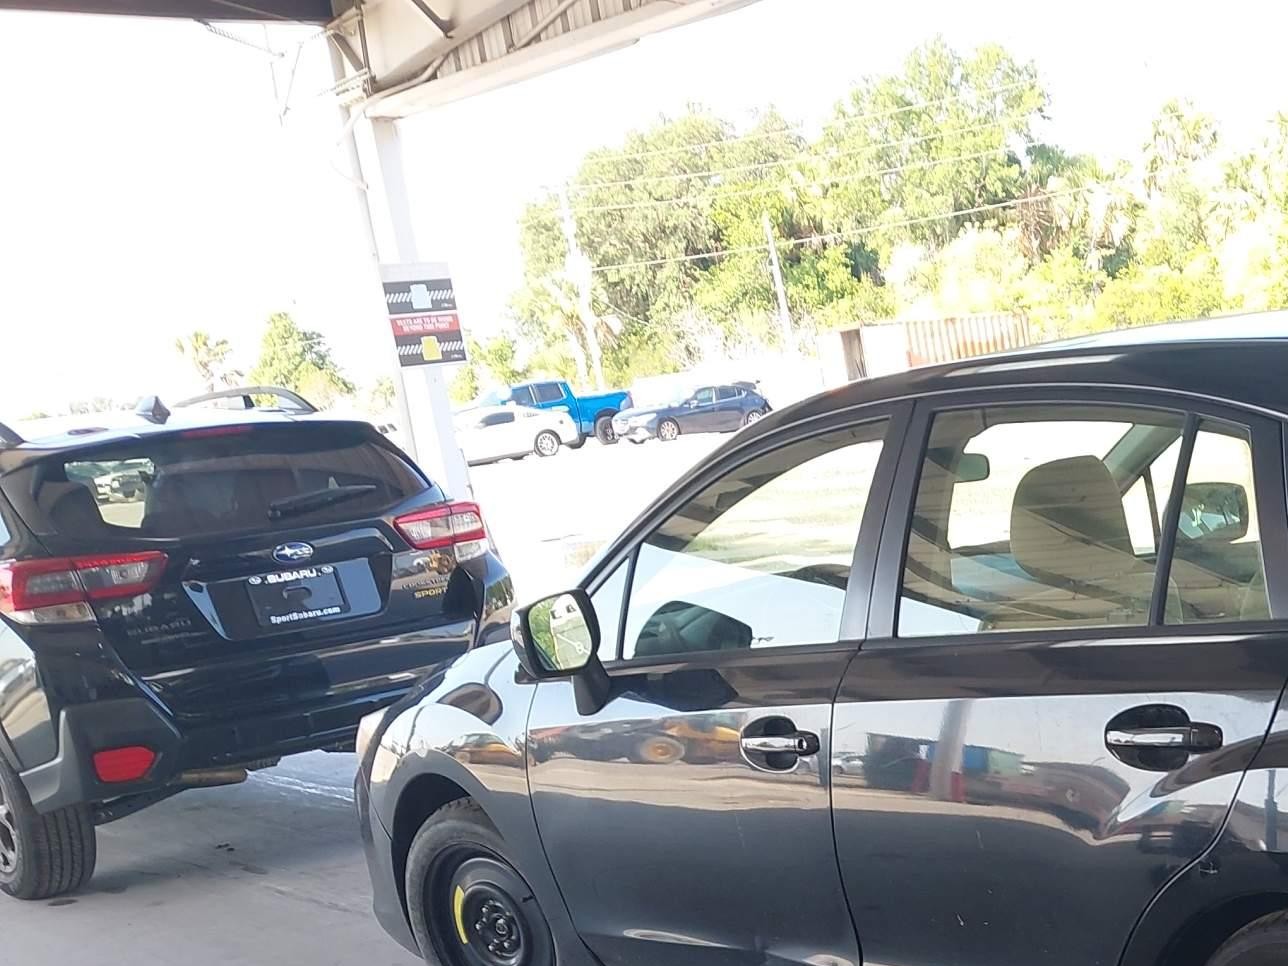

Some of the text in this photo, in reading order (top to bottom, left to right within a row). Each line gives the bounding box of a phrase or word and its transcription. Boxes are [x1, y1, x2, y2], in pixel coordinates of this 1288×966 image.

[267, 569, 317, 583] SUBARU
[415, 587, 448, 598] SPORT
[270, 606, 341, 624] SportSubaru.com
